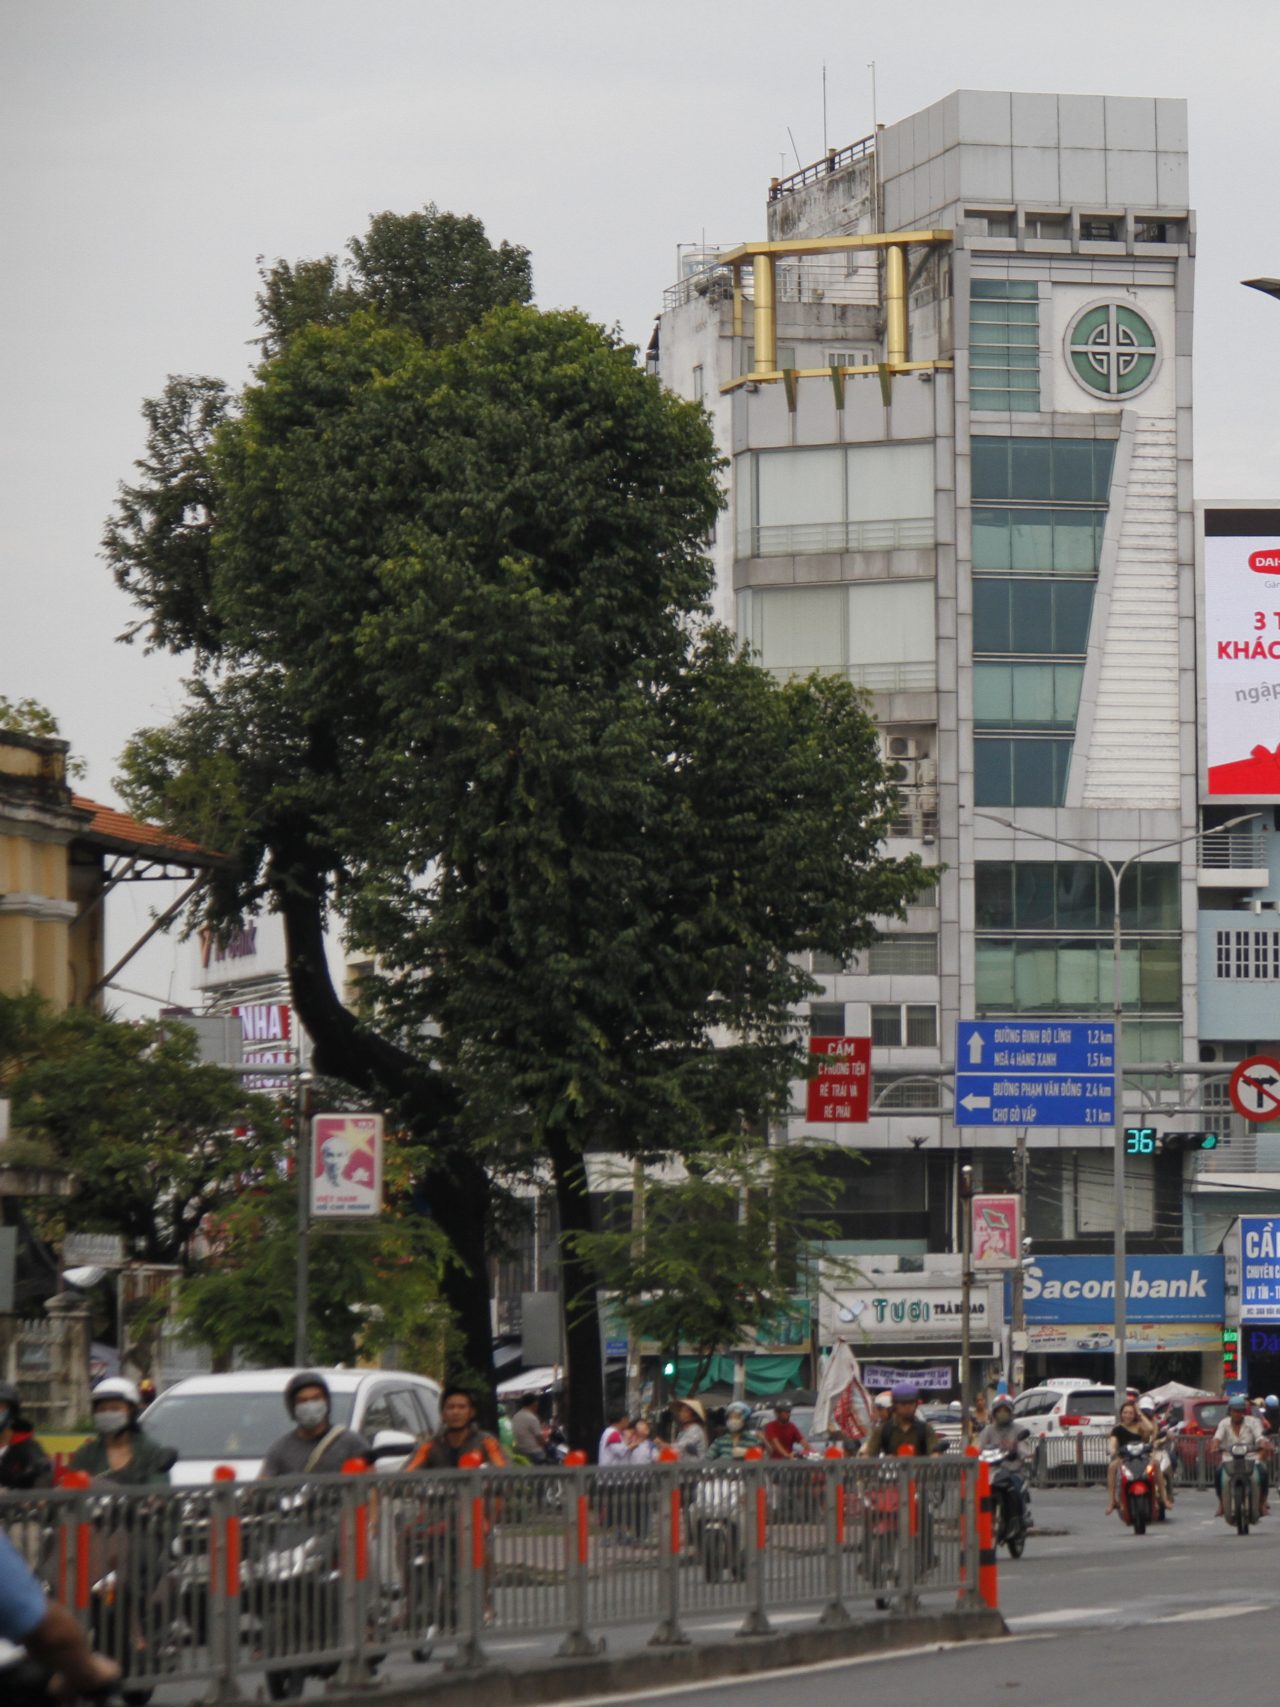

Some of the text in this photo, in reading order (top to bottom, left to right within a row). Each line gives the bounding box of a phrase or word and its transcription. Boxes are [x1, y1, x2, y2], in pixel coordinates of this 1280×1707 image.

[1254, 611, 1266, 630] 3
[239, 1005, 282, 1040] NHA
[1100, 1030, 1113, 1044] km
[1010, 1053, 1015, 1066] 4
[1036, 1053, 1057, 1066] XANH
[1100, 1053, 1112, 1067] km
[1098, 1083, 1111, 1097] km
[1098, 1108, 1111, 1123] km
[1127, 1129, 1153, 1153] 36
[1023, 1265, 1208, 1300] Sacombank
[1246, 1286, 1256, 1299] UY
